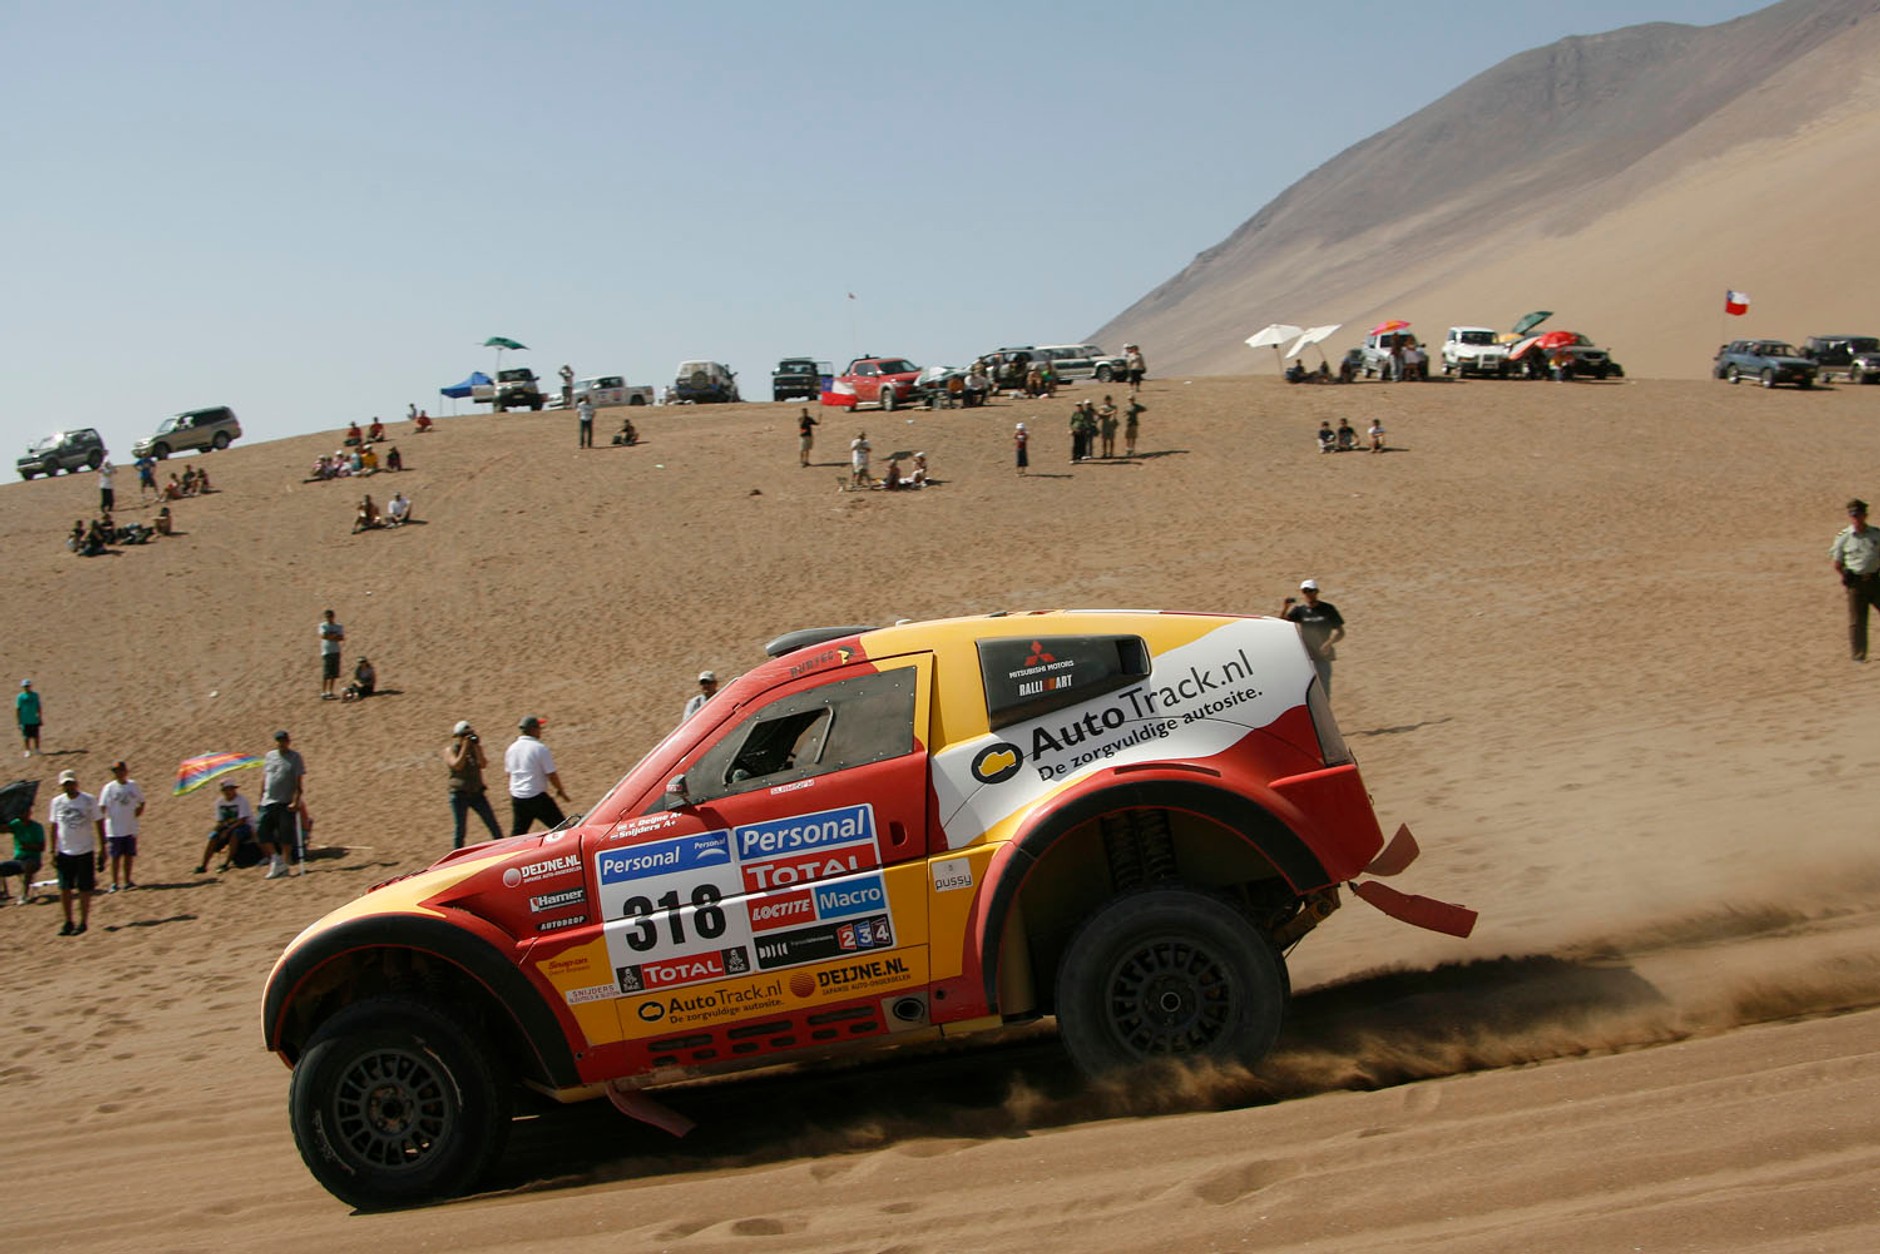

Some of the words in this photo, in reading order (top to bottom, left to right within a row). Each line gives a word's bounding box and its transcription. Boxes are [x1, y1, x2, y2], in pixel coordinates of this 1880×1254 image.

[1009, 665, 1047, 679] MITSUBISHI
[1047, 660, 1074, 671] MOTORS
[1031, 648, 1255, 761] AutoTrack.nl
[1037, 764, 1067, 782] De
[1070, 718, 1179, 768] zorgvuldige
[1181, 687, 1264, 724] autosite.
[619, 824, 660, 836] Snijders
[743, 809, 865, 855] Personal
[694, 837, 726, 850] Personal
[521, 854, 582, 878] DEIJNE.NL
[603, 846, 680, 876] Personal
[935, 873, 973, 891] pussy
[538, 889, 583, 907] Hamer
[752, 898, 811, 921] LOCTITE
[819, 887, 881, 911] Macro
[541, 916, 584, 930] AUTODROP
[623, 885, 726, 951] 318
[842, 930, 856, 947] 2
[859, 928, 872, 944] 3
[876, 924, 889, 941] 4
[644, 960, 722, 983] TOTAL
[817, 957, 909, 988] DEIJNE.NL
[668, 978, 783, 1015] AutoTrack.nl
